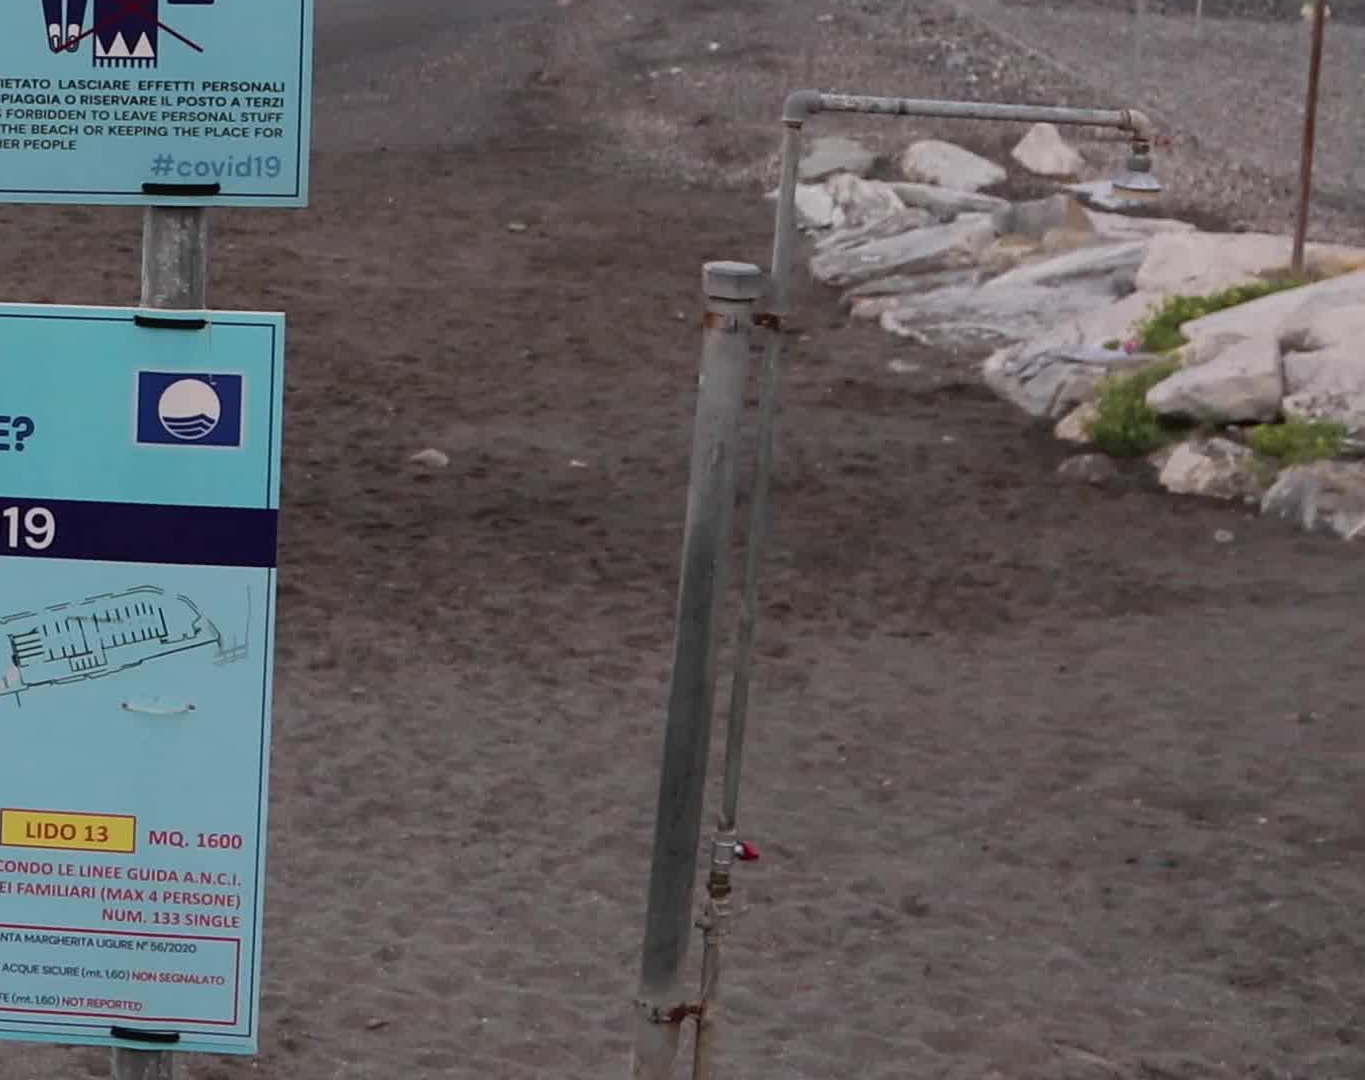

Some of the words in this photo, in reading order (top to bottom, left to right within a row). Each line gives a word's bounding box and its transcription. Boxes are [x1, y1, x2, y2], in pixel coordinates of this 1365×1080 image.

[58, 79, 130, 90] LASCIARE
[137, 80, 195, 91] EFFETTI
[201, 81, 285, 92] PERSONALI
[150, 155, 280, 177] #covid19
[25, 822, 76, 840] LIDO
[84, 825, 108, 842] 13
[148, 830, 189, 847] MQ.
[196, 833, 242, 848] 1600
[57, 863, 74, 876] LE
[78, 865, 121, 879] LINEE
[126, 868, 178, 881] GUIDA
[182, 872, 241, 885] A.N.C.I.
[16, 883, 96, 897] FAMILIARI
[100, 887, 143, 901] (MAX
[148, 890, 157, 902] 4
[162, 891, 241, 908] PERSONE)
[101, 909, 147, 922] NUM.
[152, 912, 180, 924] 133
[184, 914, 239, 928] SINGLE
[23, 934, 94, 946] MARGHERITA
[149, 941, 197, 953] 56/2020
